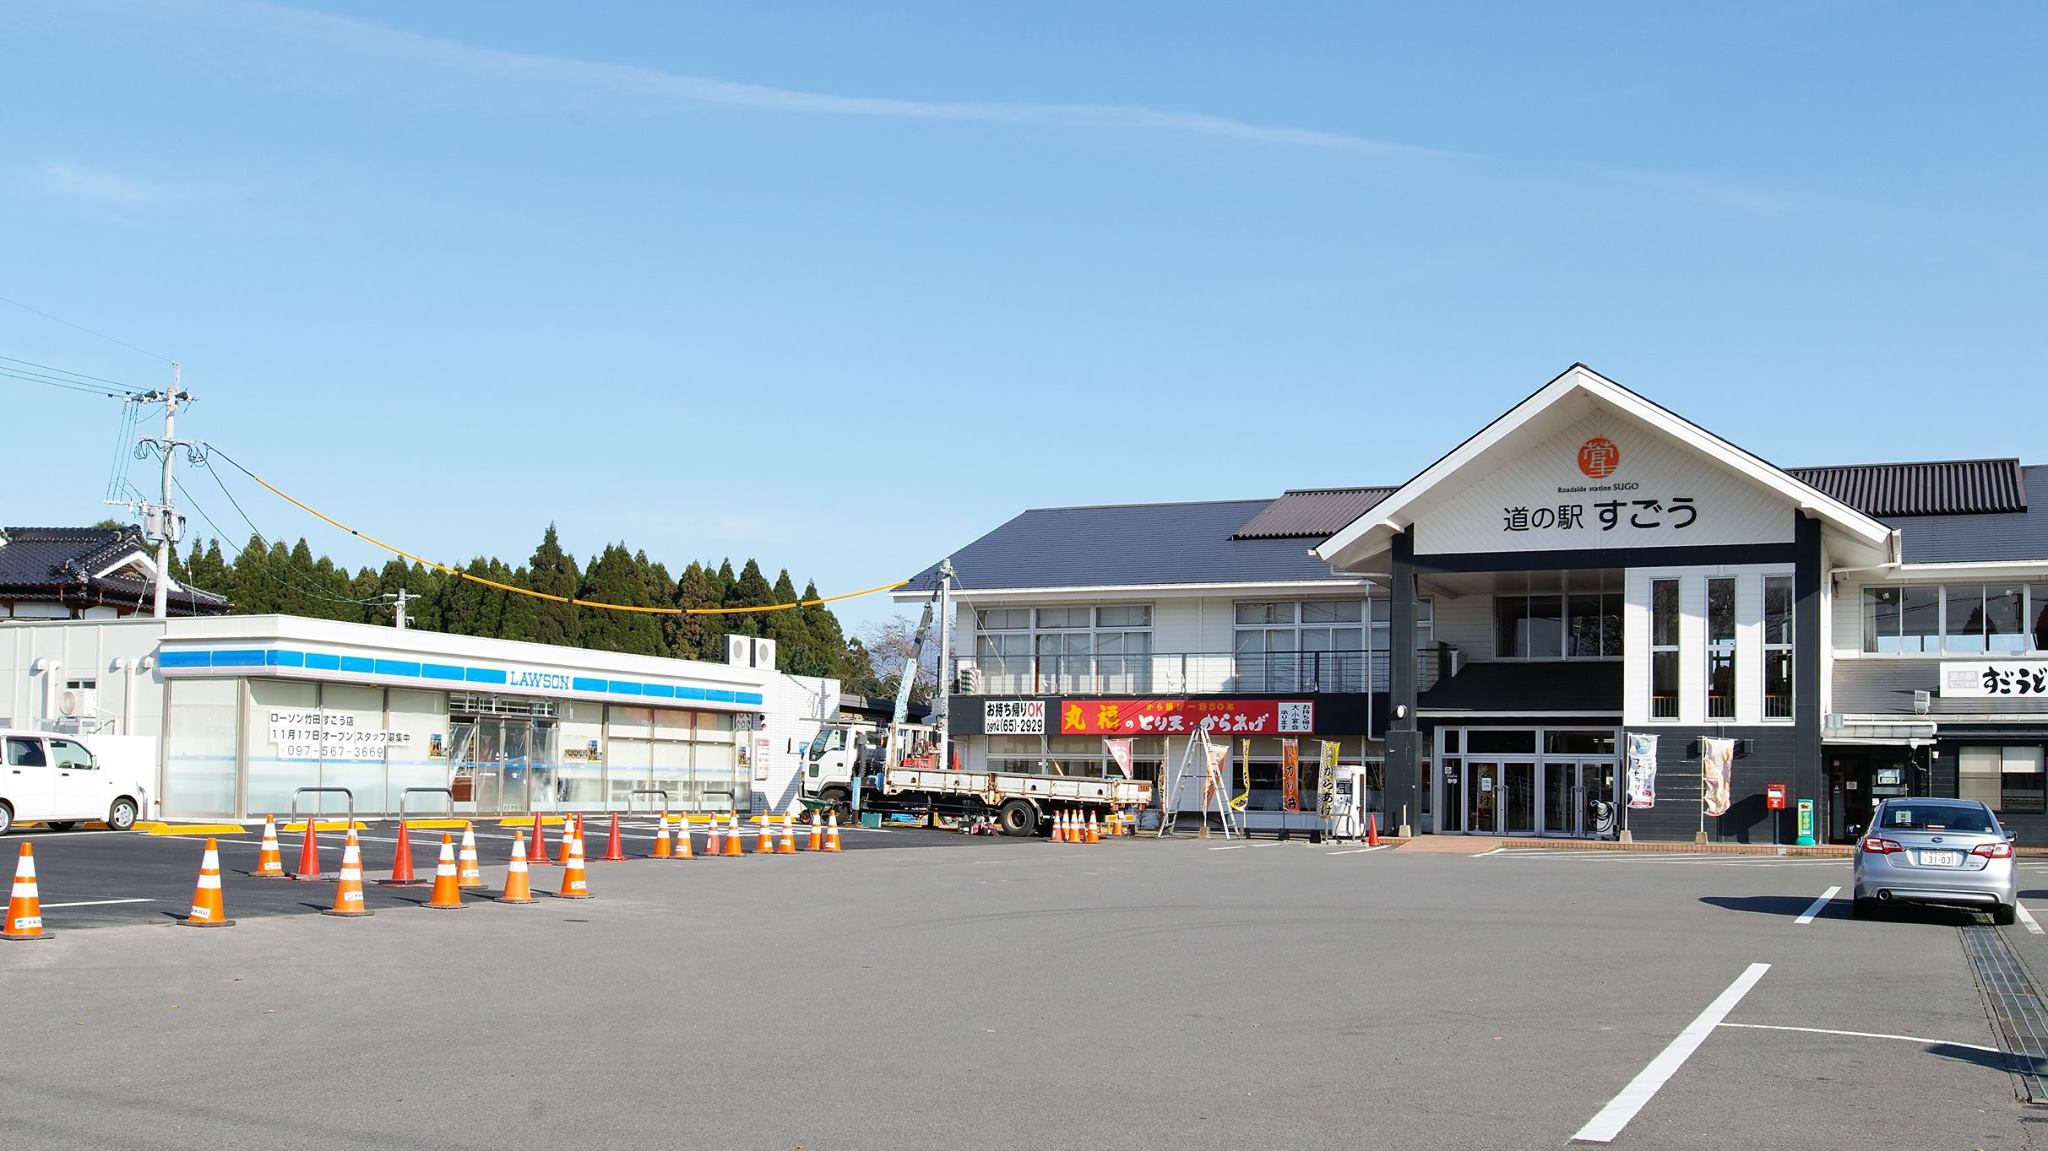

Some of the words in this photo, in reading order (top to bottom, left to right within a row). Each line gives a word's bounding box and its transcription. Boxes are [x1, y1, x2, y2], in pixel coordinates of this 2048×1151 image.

[1613, 482, 1639, 491] SUGO
[1503, 505, 1584, 532] 道の駅
[1593, 497, 1697, 531] すごう
[510, 671, 570, 690] LAWSON
[1983, 666, 2047, 694] すごうど
[987, 702, 1043, 717] お持ち帰りOK
[287, 745, 384, 757] 097-567-3669
